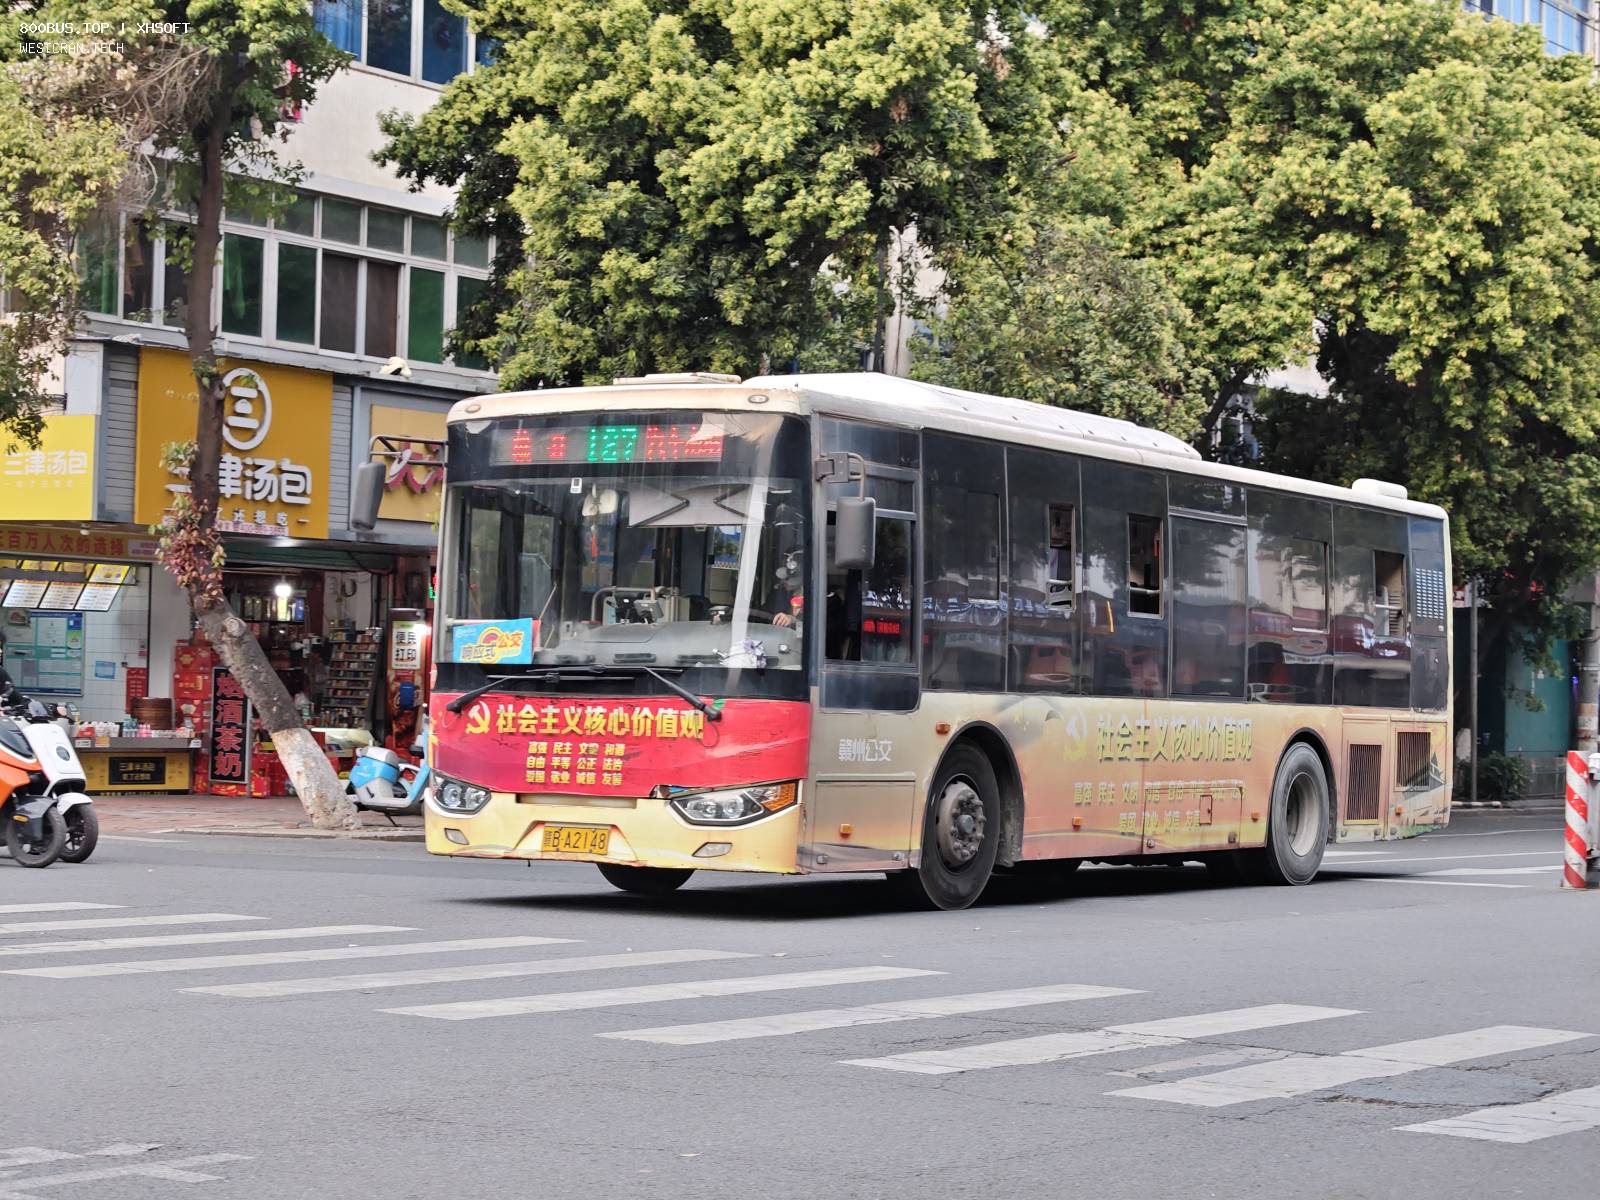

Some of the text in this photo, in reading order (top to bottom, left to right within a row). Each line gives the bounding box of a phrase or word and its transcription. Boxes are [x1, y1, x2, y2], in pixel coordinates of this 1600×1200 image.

[4, 450, 88, 476] 三津汤包
[496, 703, 704, 739] 社会主义核心价值观
[553, 742, 573, 755] 民主
[1097, 713, 1253, 762] 社会主义核心价值观
[526, 756, 546, 769] 自由
[577, 757, 597, 770] 公正
